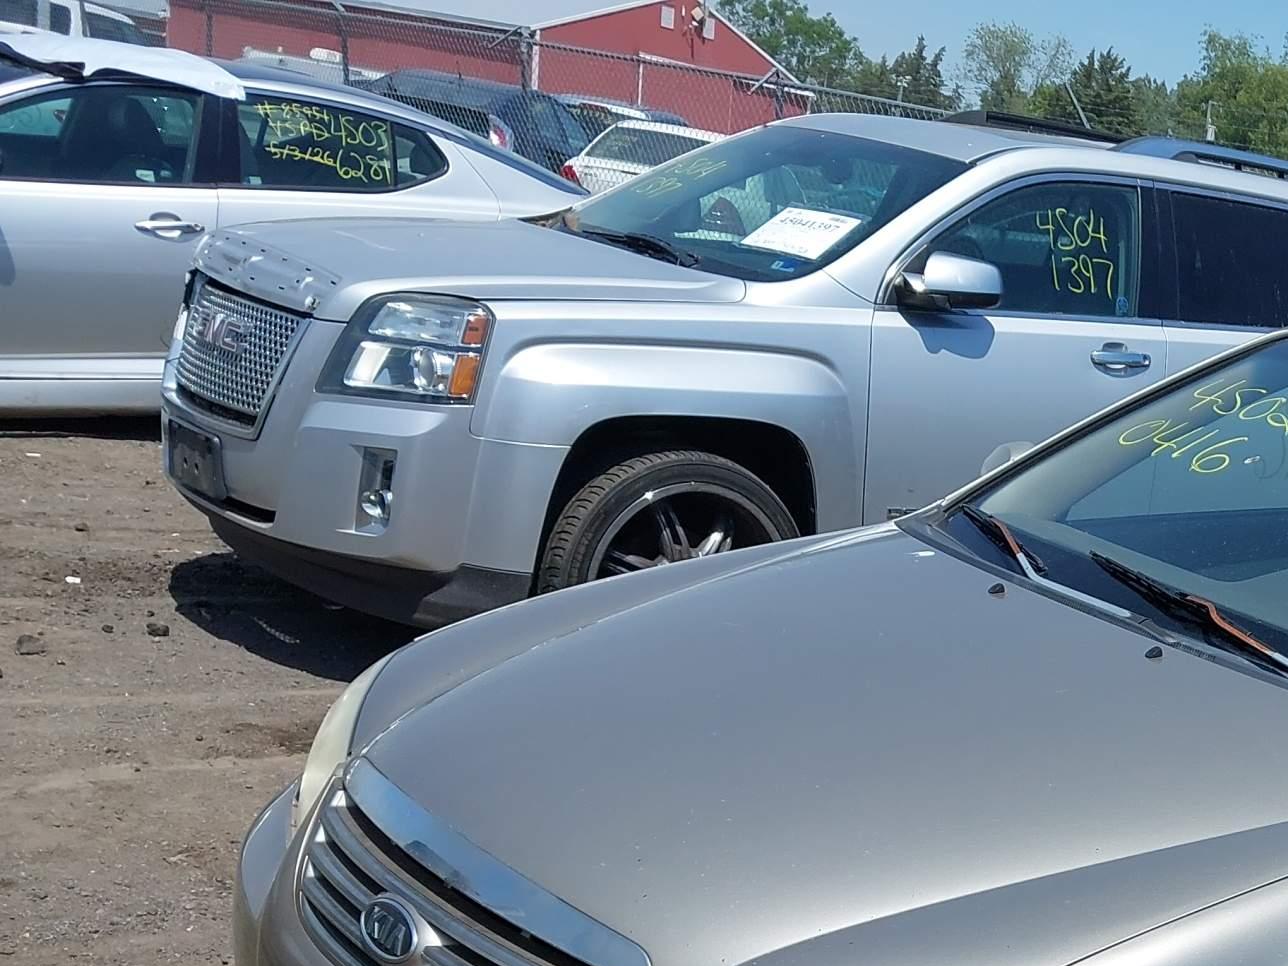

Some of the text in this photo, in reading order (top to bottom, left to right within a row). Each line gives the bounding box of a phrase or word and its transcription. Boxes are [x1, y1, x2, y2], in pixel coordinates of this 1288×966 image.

[330, 113, 388, 151] 4503
[1036, 207, 1108, 253] 4504
[1051, 252, 1114, 301] 1397
[1118, 419, 1249, 473] 0416
[366, 905, 407, 956] KIA
